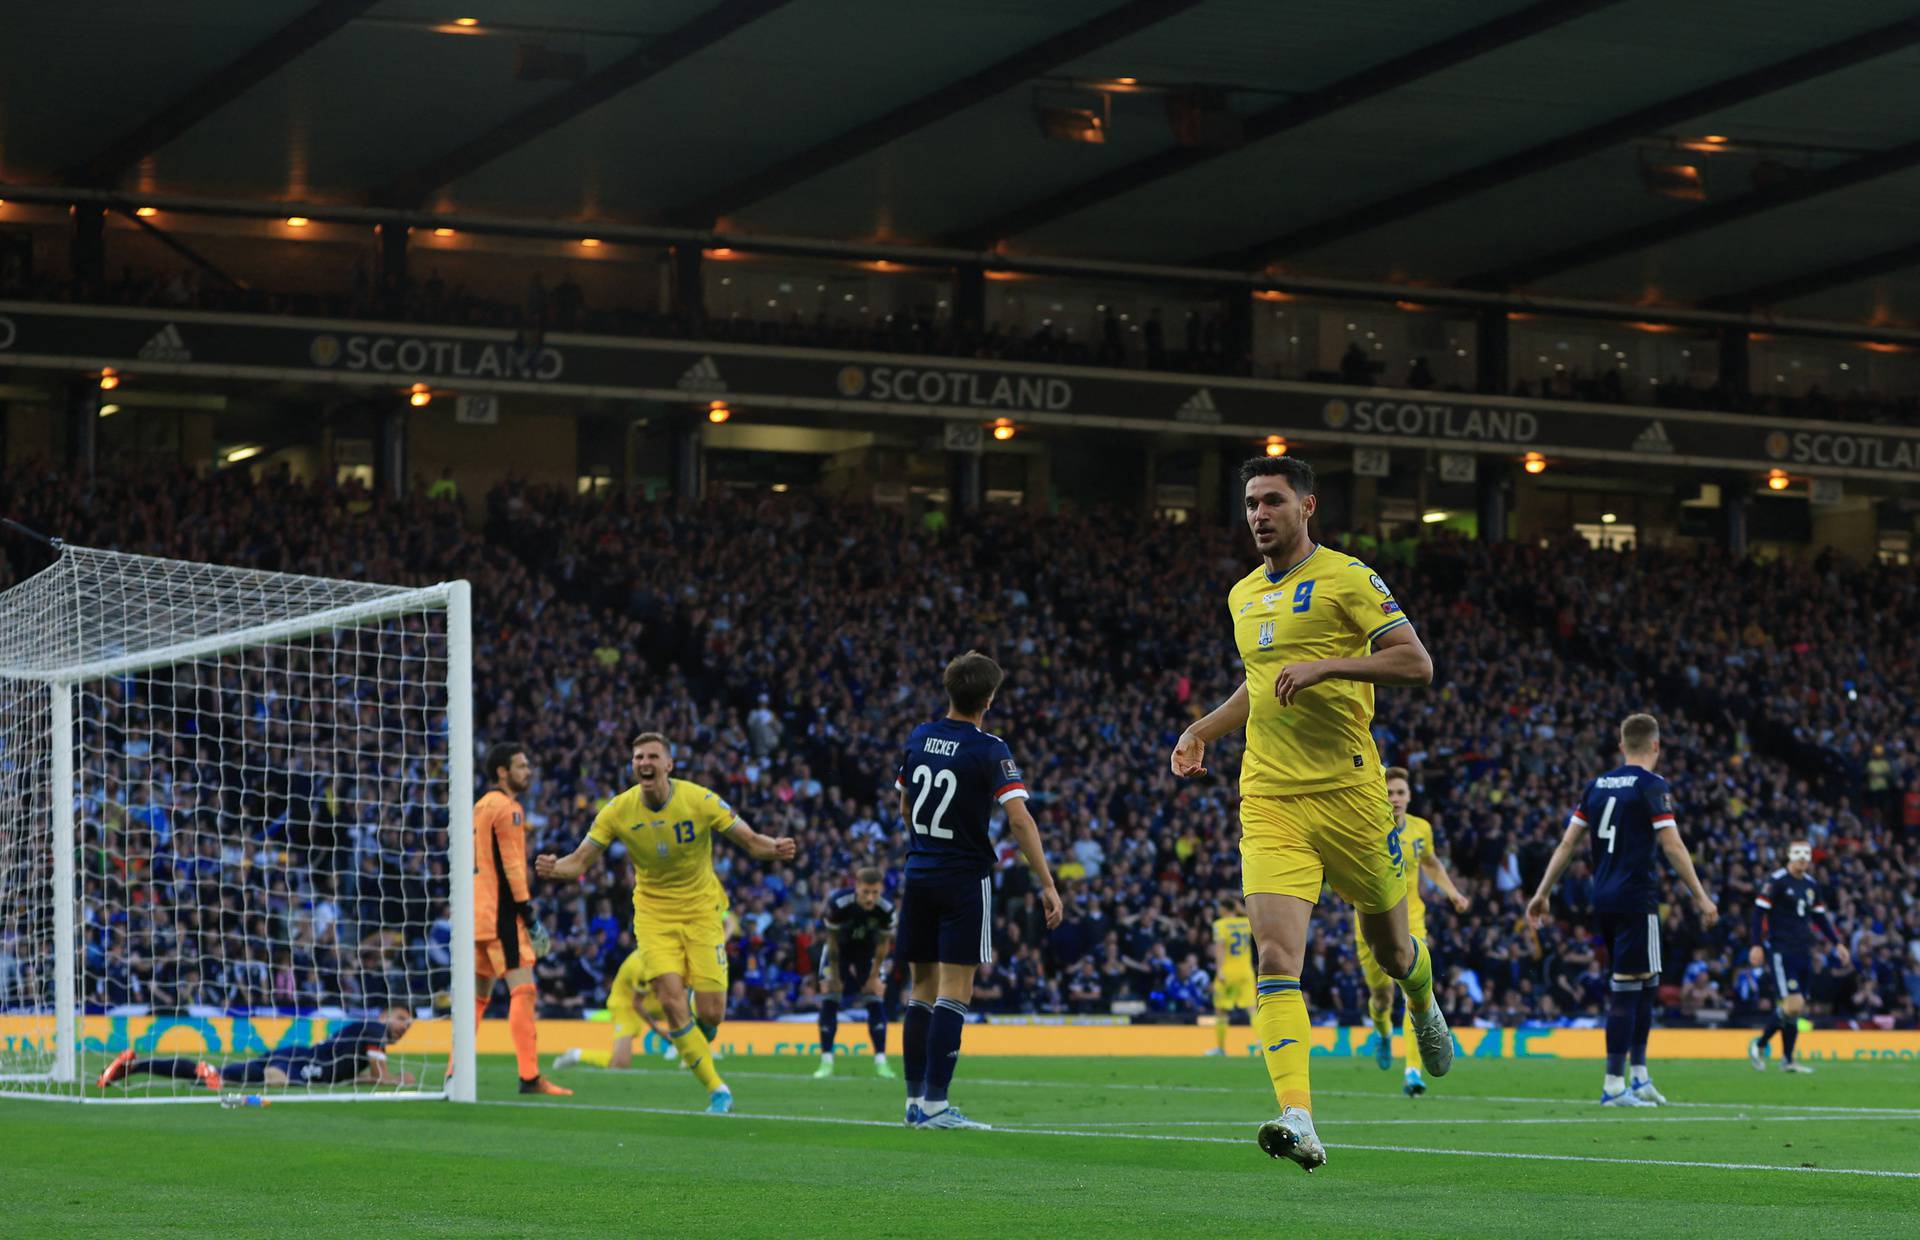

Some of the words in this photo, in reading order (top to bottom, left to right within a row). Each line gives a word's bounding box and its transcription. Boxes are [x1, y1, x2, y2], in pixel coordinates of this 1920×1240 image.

[870, 366, 1073, 411] SCOTLAND
[1353, 399, 1540, 443] SCOTLAND
[1792, 432, 1920, 469] SCOTLA
[1293, 579, 1316, 613] 9
[923, 737, 960, 757] HICKEY
[911, 764, 958, 840] 22
[672, 820, 697, 844] 13
[1597, 796, 1617, 855] 4
[1387, 827, 1402, 866] 9
